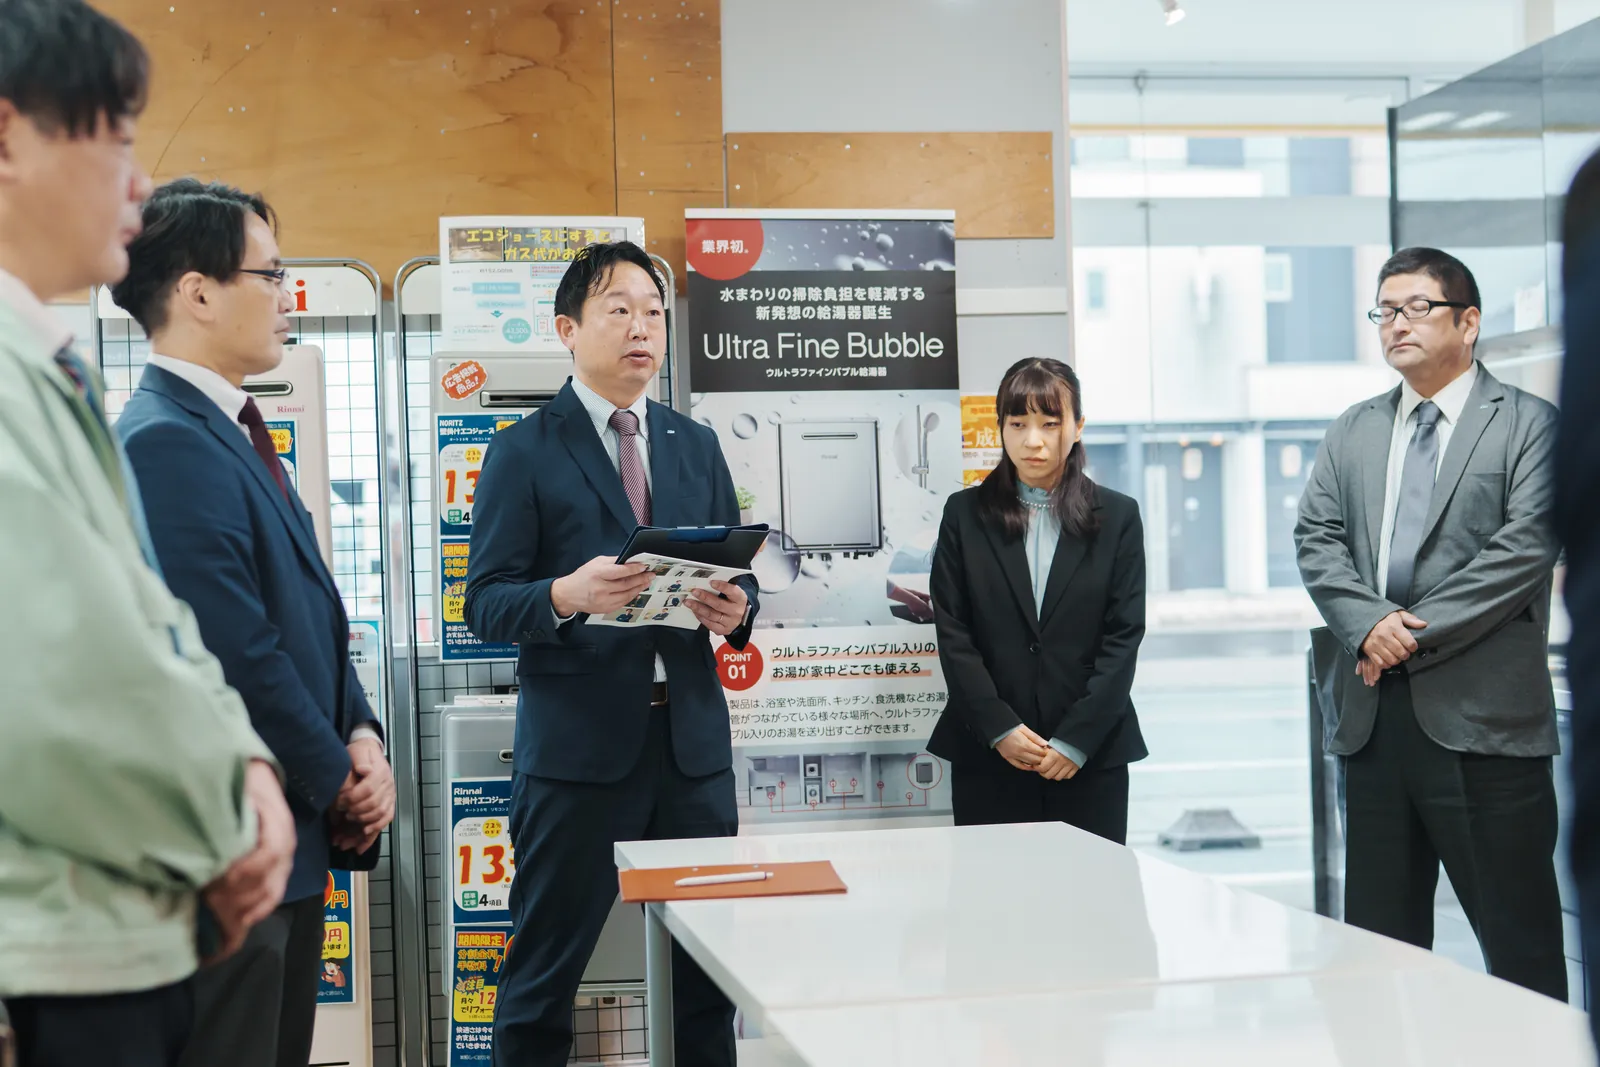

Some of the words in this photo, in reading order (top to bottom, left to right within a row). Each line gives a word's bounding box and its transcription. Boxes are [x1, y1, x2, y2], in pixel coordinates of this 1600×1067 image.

[702, 239, 749, 254] 業界初。
[720, 286, 926, 302] 水まわりの掃除負担を軽減する
[756, 305, 892, 321] 新発想の給湯器誕生
[703, 333, 770, 359] Ultra
[778, 332, 840, 359] Fine
[847, 331, 944, 358] Bubble
[766, 366, 887, 378] ウルトラファインバブル給湯器
[723, 652, 752, 663] POINT
[771, 641, 936, 659] ウルトラファインバブル入りの
[727, 664, 747, 680] 01
[772, 662, 921, 679] お湯が家中どこでも使える
[454, 787, 482, 795] Rinnai
[454, 796, 513, 805] 壁掛けエコジョー
[331, 889, 349, 909] 円
[458, 934, 502, 946] 期間限定
[461, 997, 474, 1005] 月々
[461, 1005, 494, 1014] でリフォー
